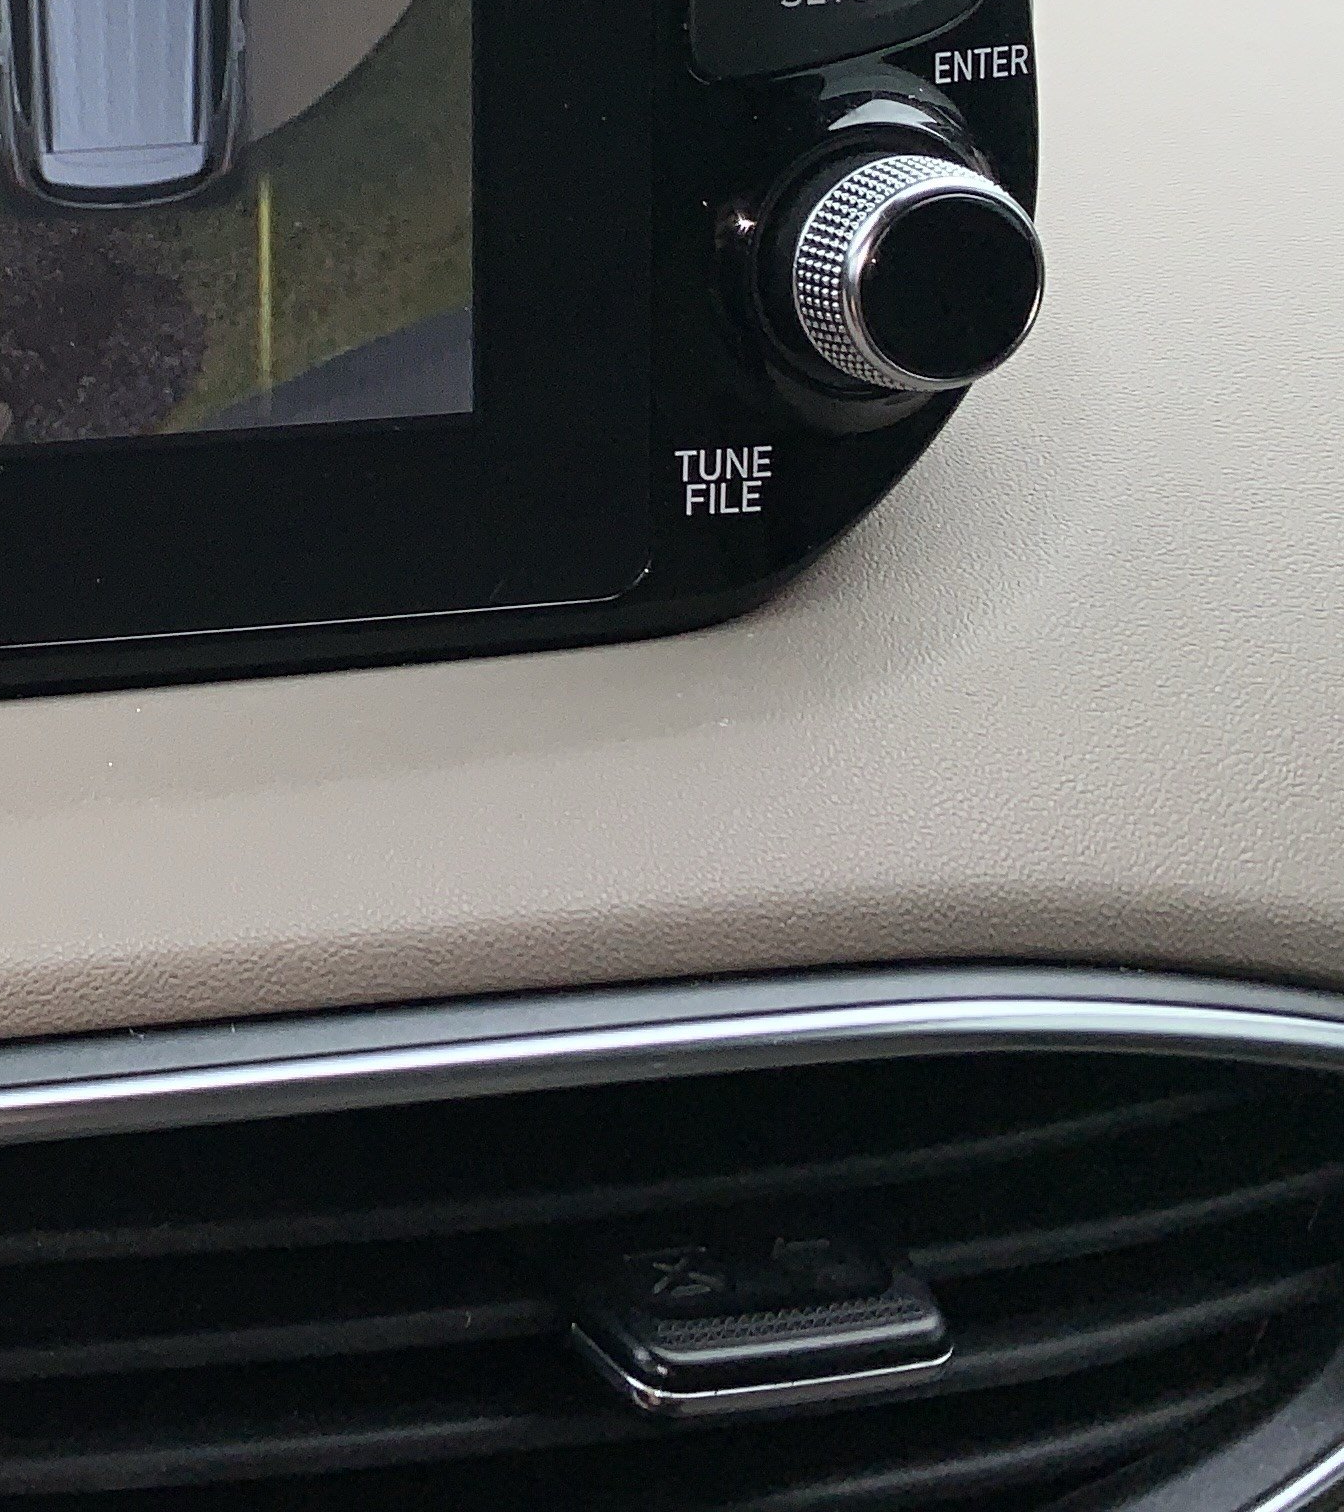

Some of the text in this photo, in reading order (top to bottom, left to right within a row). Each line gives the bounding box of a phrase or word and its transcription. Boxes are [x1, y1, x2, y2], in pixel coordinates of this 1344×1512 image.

[933, 44, 1030, 85] ENTER
[674, 445, 773, 482] TUNE
[684, 480, 763, 517] FILE
